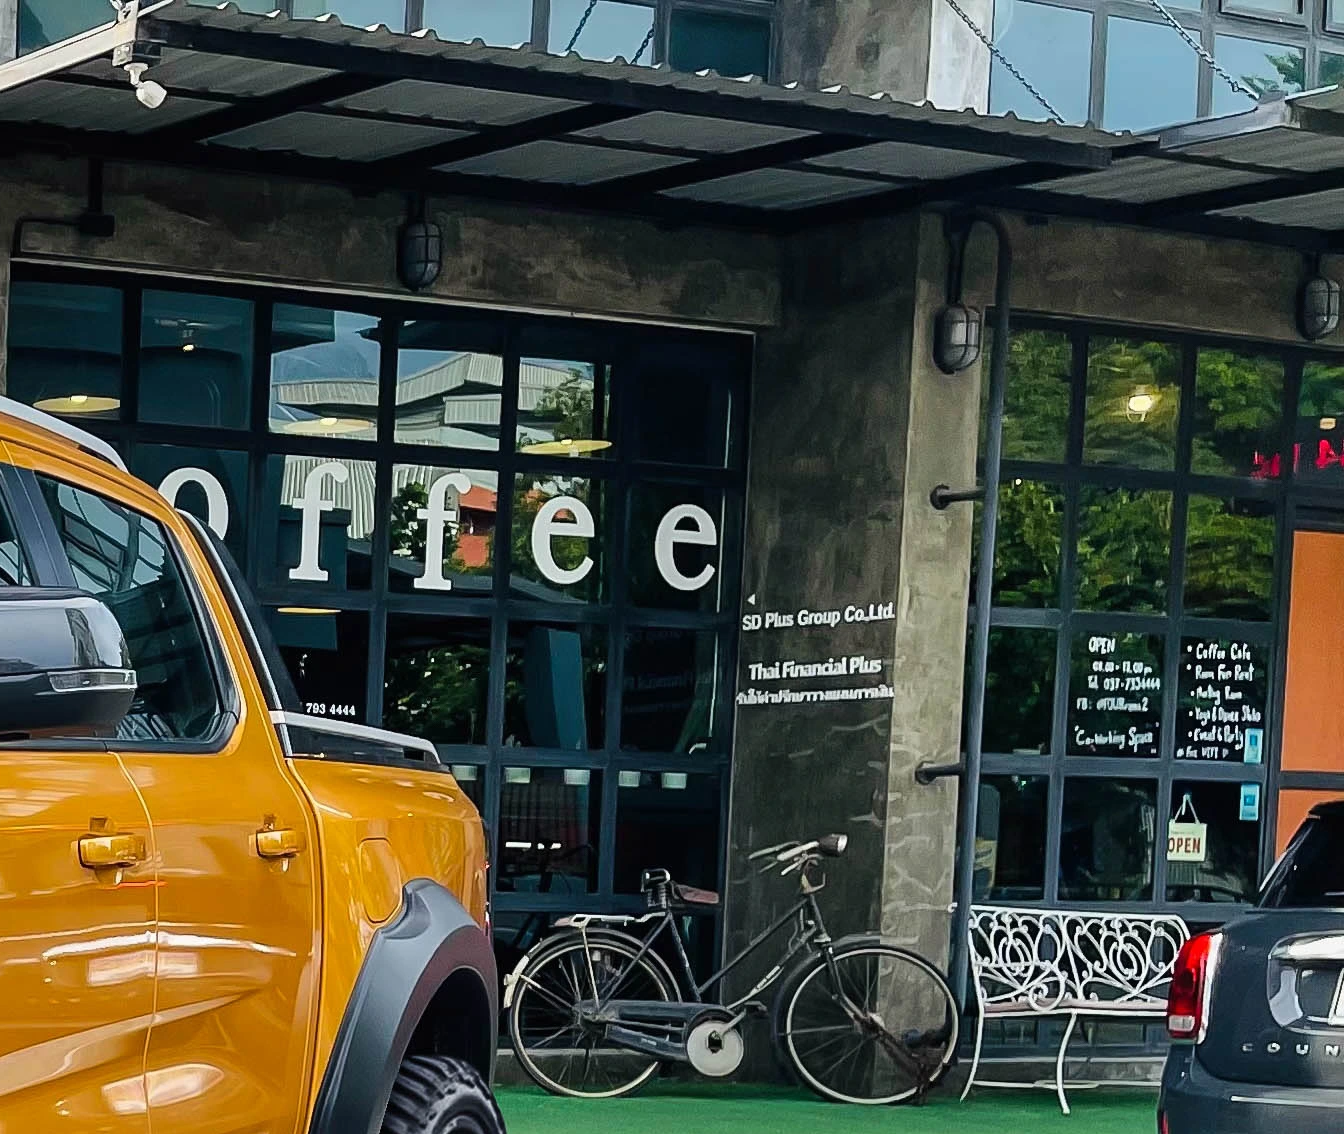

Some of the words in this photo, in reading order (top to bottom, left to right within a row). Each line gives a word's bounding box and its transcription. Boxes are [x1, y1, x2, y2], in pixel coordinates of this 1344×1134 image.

[742, 614, 762, 631] SD
[765, 612, 794, 628] Plus
[797, 609, 841, 628] Group
[1088, 636, 1116, 655] OPEN
[1196, 642, 1226, 660] Coffee
[749, 661, 781, 680] Thai
[782, 657, 848, 679] Financial
[849, 655, 882, 674] Plus
[305, 702, 326, 715] 793
[329, 704, 356, 716] 4444
[1168, 837, 1201, 854] OPEN
